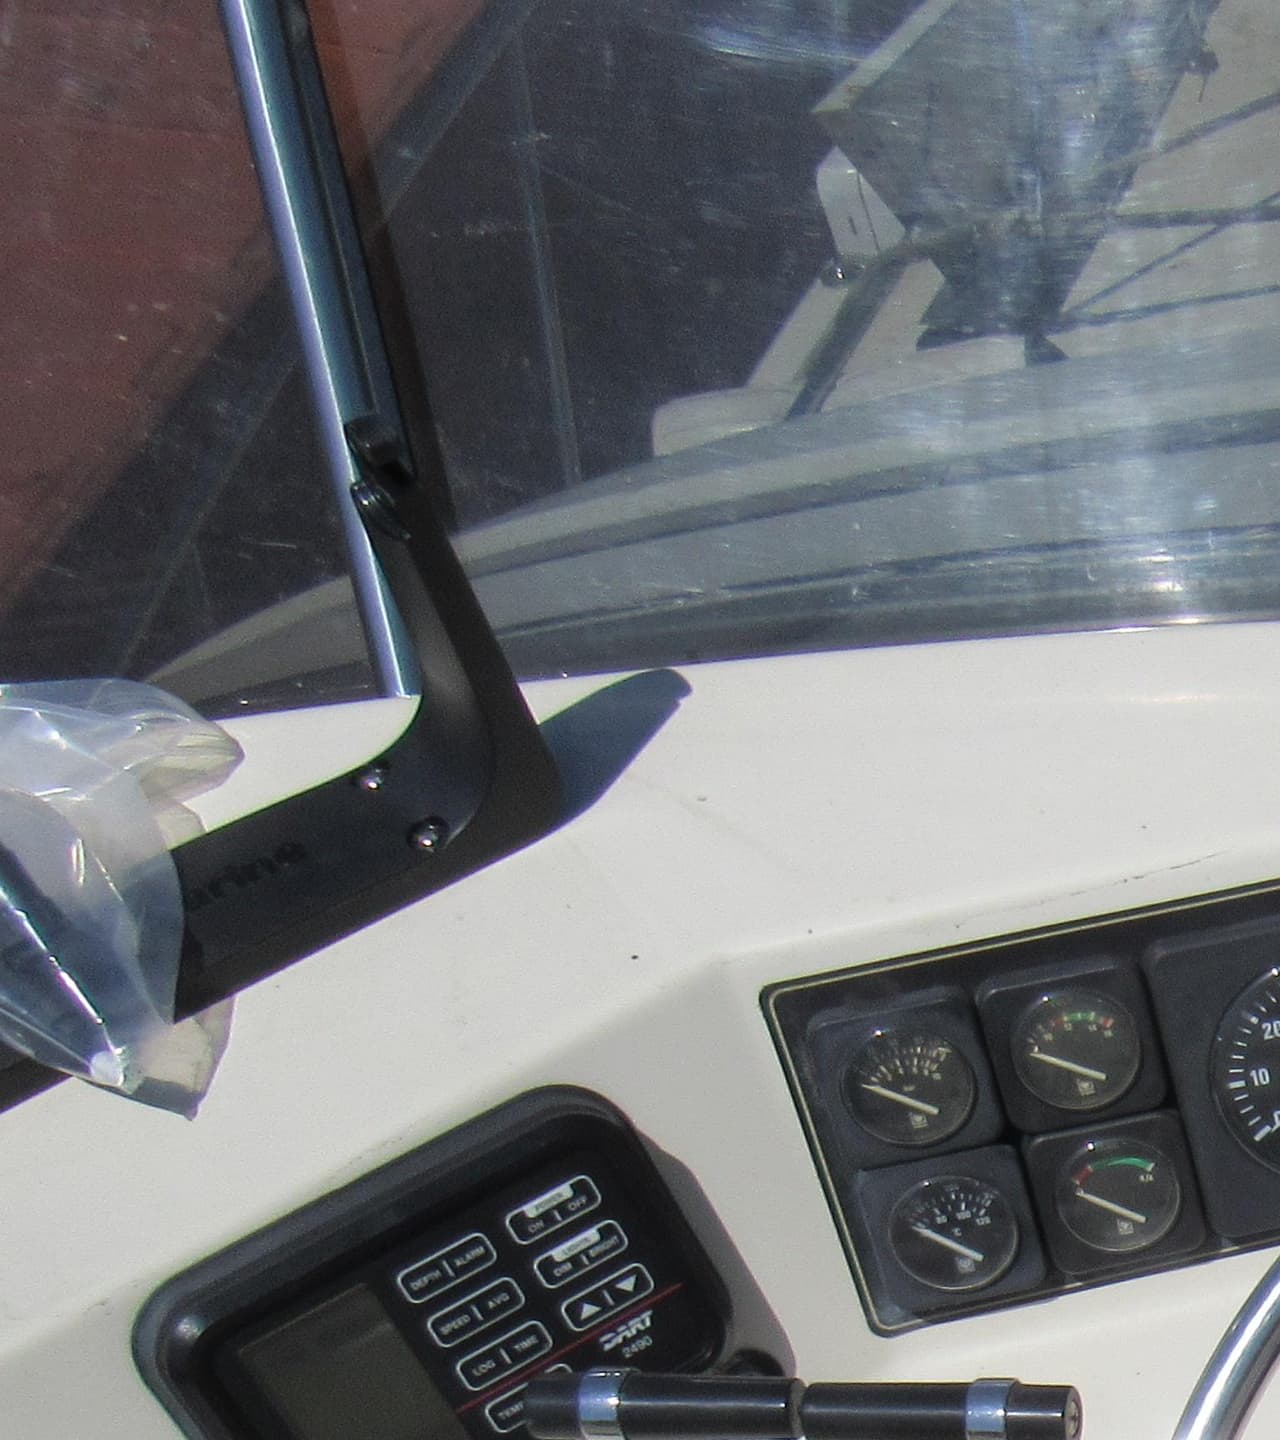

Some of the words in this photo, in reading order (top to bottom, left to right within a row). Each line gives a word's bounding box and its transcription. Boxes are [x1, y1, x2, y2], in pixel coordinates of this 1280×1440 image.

[1250, 1068, 1270, 1086] 10
[528, 1221, 544, 1234] ON
[568, 1195, 587, 1212] OFF
[410, 1269, 442, 1291] DEPTH
[453, 1246, 486, 1268] ALARM
[439, 1314, 472, 1336] SPEED
[487, 1293, 510, 1310] AVG
[600, 1310, 653, 1351] DART
[472, 1360, 496, 1377] LOG
[514, 1335, 540, 1353] TIME
[622, 1335, 653, 1358] 2490
